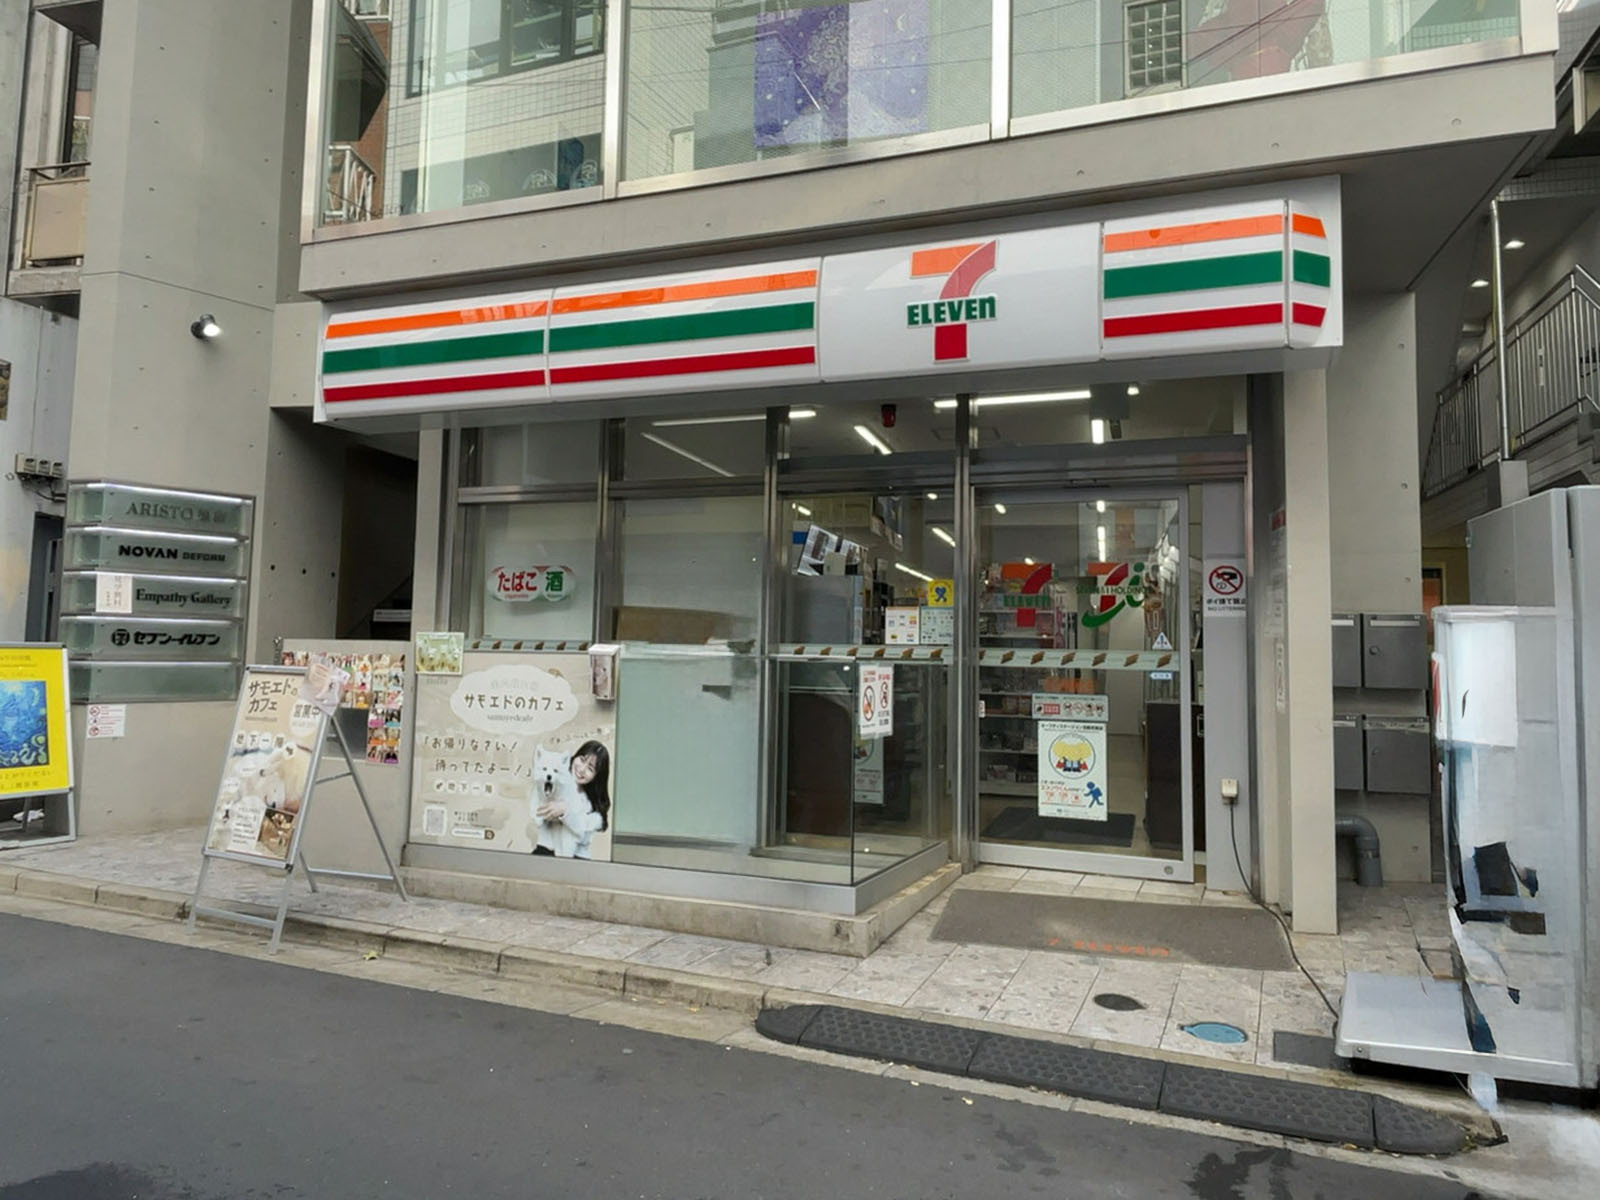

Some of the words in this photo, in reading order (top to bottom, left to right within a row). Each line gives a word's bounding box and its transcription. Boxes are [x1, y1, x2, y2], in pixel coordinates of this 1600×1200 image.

[126, 501, 193, 520] ARISTO
[118, 545, 178, 560] NOVAN
[497, 571, 538, 592] たばこ
[545, 571, 564, 592] 酒
[136, 588, 188, 607] Empathy
[191, 591, 231, 609] Gallery
[248, 698, 278, 714] カフェ
[464, 693, 564, 712] サモエドのカフェ
